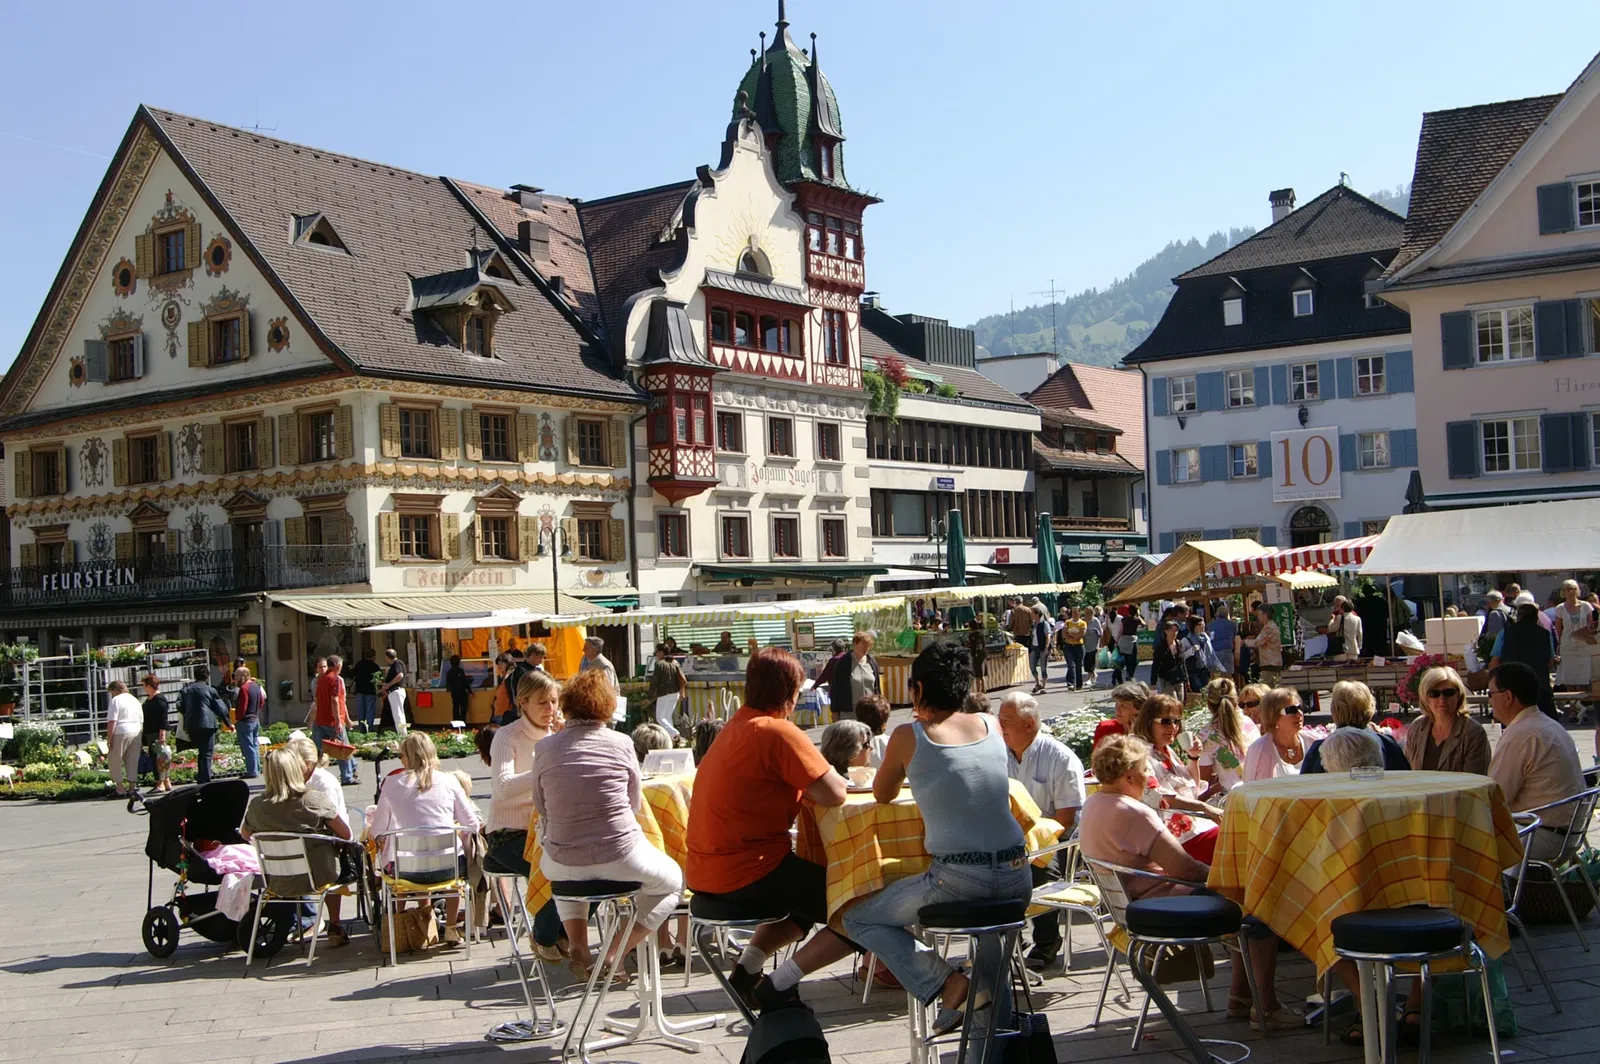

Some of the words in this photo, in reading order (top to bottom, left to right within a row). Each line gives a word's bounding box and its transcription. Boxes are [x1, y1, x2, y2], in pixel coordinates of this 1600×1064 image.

[1554, 376, 1600, 393] Hirs
[1278, 435, 1333, 488] 10
[751, 462, 787, 486] Johann
[42, 567, 135, 591] FEURSTEIN
[416, 568, 504, 588] Feurstein
